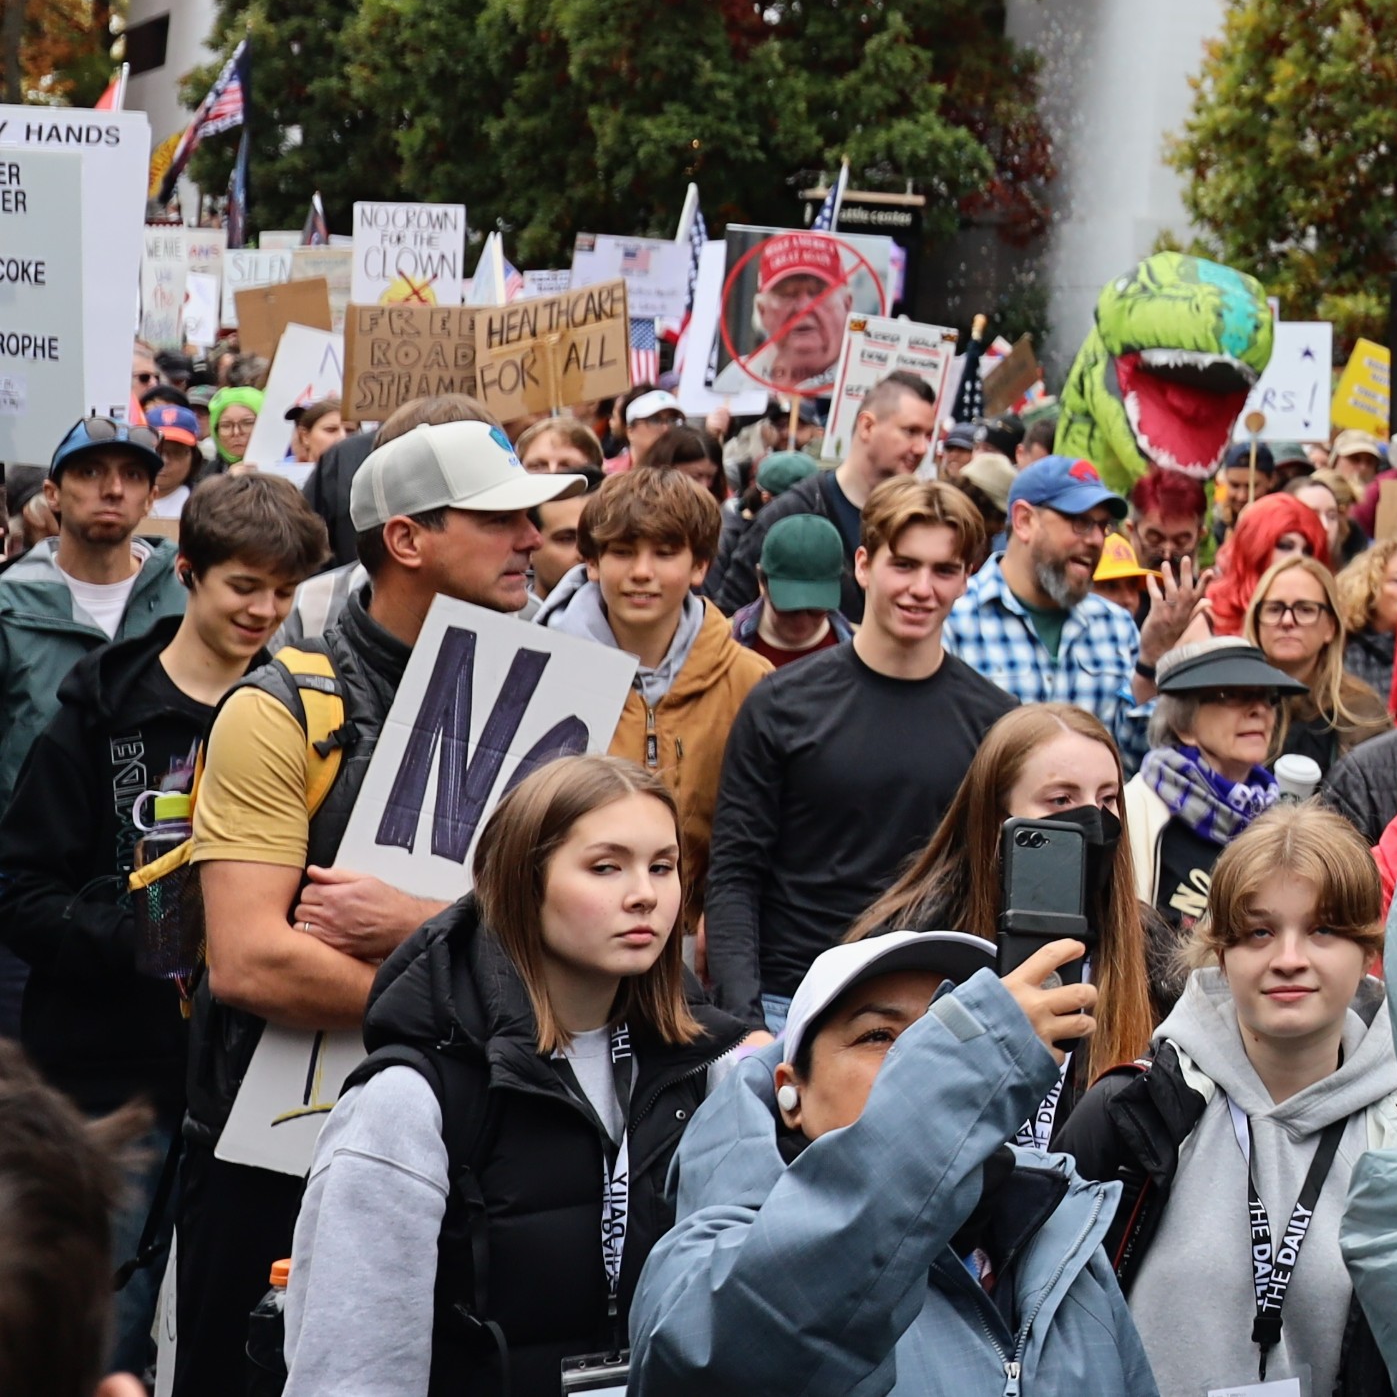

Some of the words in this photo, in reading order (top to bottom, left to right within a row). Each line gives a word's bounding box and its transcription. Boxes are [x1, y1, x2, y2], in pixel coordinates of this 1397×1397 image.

[26, 122, 121, 147] HANDS
[360, 205, 388, 229] NO
[390, 205, 457, 230] CROWN
[380, 231, 409, 247] FOR
[413, 230, 440, 247] THE
[364, 249, 456, 281] CLOWN
[359, 308, 475, 337] FREE
[371, 341, 475, 369] ROAD
[479, 352, 540, 402] FOR
[563, 339, 617, 375] ALL
[611, 1022, 632, 1063] THE
[1249, 1199, 1270, 1240] THE
[1263, 1268, 1290, 1313] THE
[1277, 1202, 1313, 1267] DAILY
